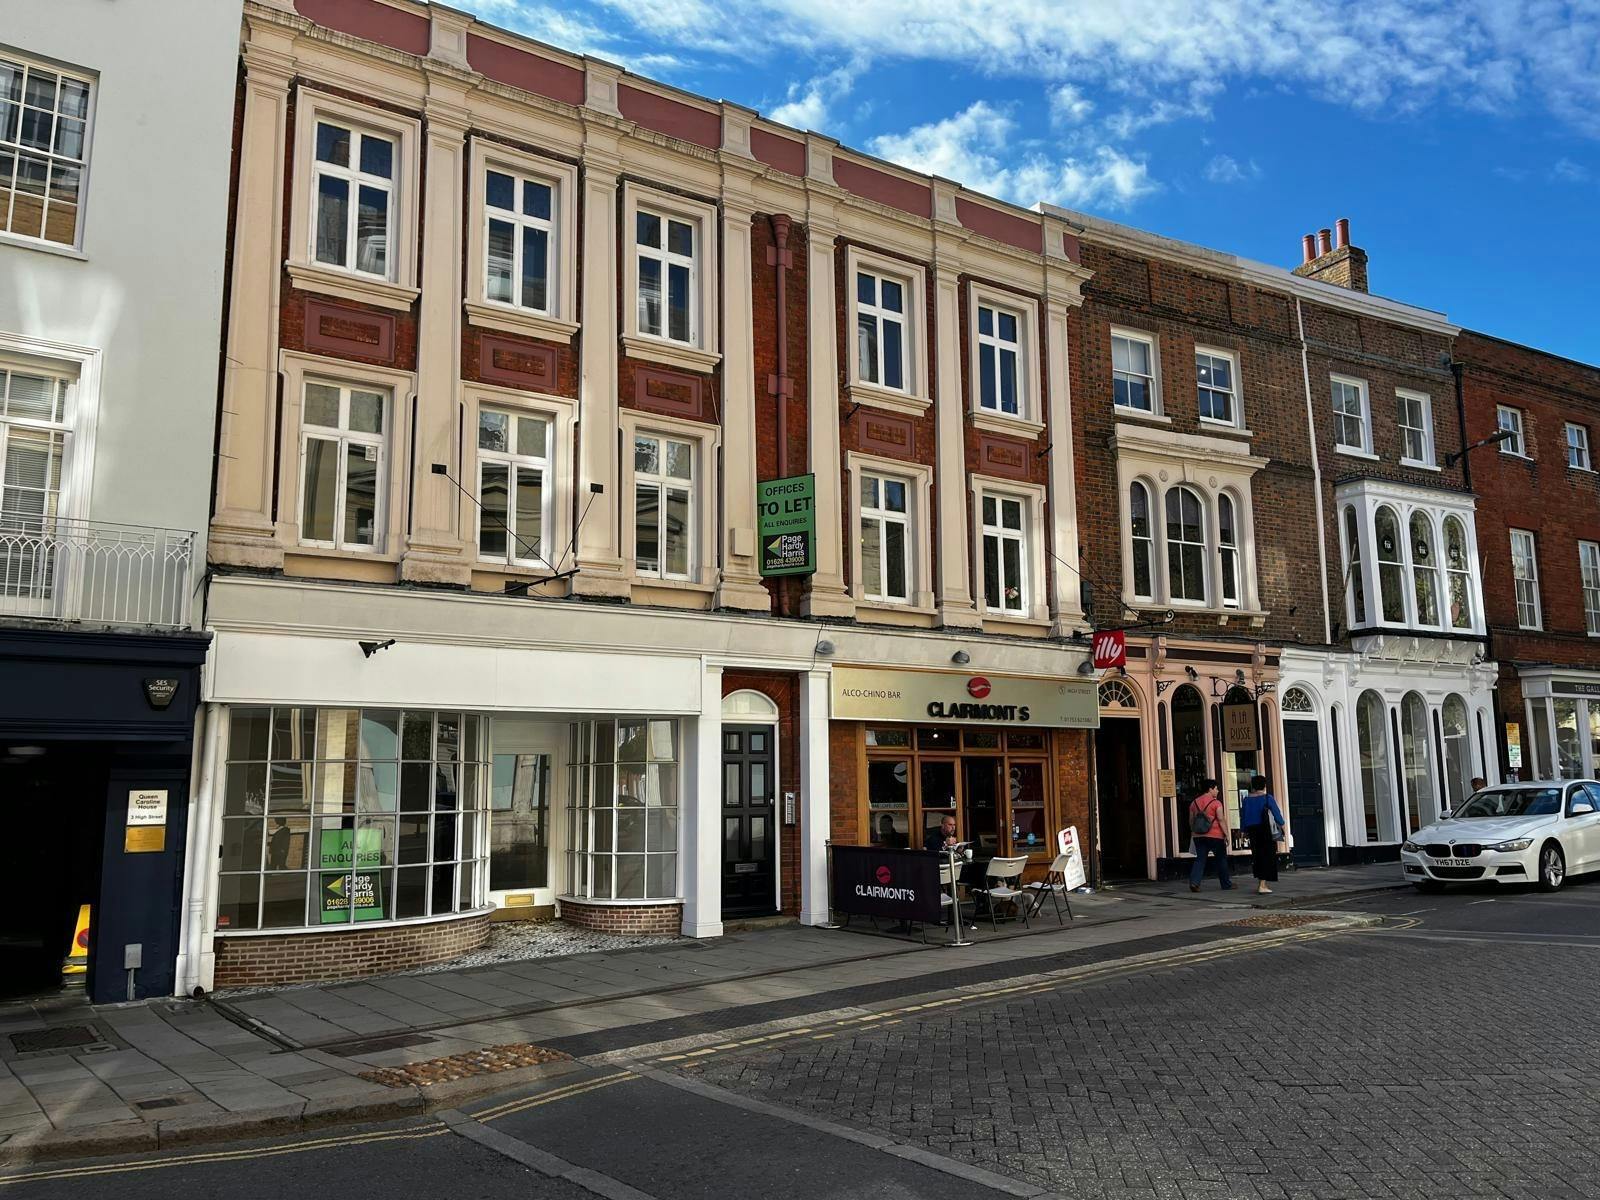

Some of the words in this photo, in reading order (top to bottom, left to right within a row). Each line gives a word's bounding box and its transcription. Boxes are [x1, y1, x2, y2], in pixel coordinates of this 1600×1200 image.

[765, 483, 805, 497] OFFICES
[758, 502, 779, 516] TO
[785, 497, 812, 513] LET
[777, 517, 807, 526] ENQUIRIES
[782, 535, 802, 544] Page
[782, 543, 804, 551] Hardy
[782, 550, 805, 558] Harris
[1095, 636, 1123, 664] illy
[148, 684, 175, 693] Security
[842, 689, 886, 698] ALCO-CHINO
[887, 691, 901, 699] BAR
[1231, 727, 1251, 740] RUSSE
[322, 852, 379, 863] ENQURIES
[855, 884, 915, 902] CLAIRMONT'S
[326, 898, 348, 906] 01628
